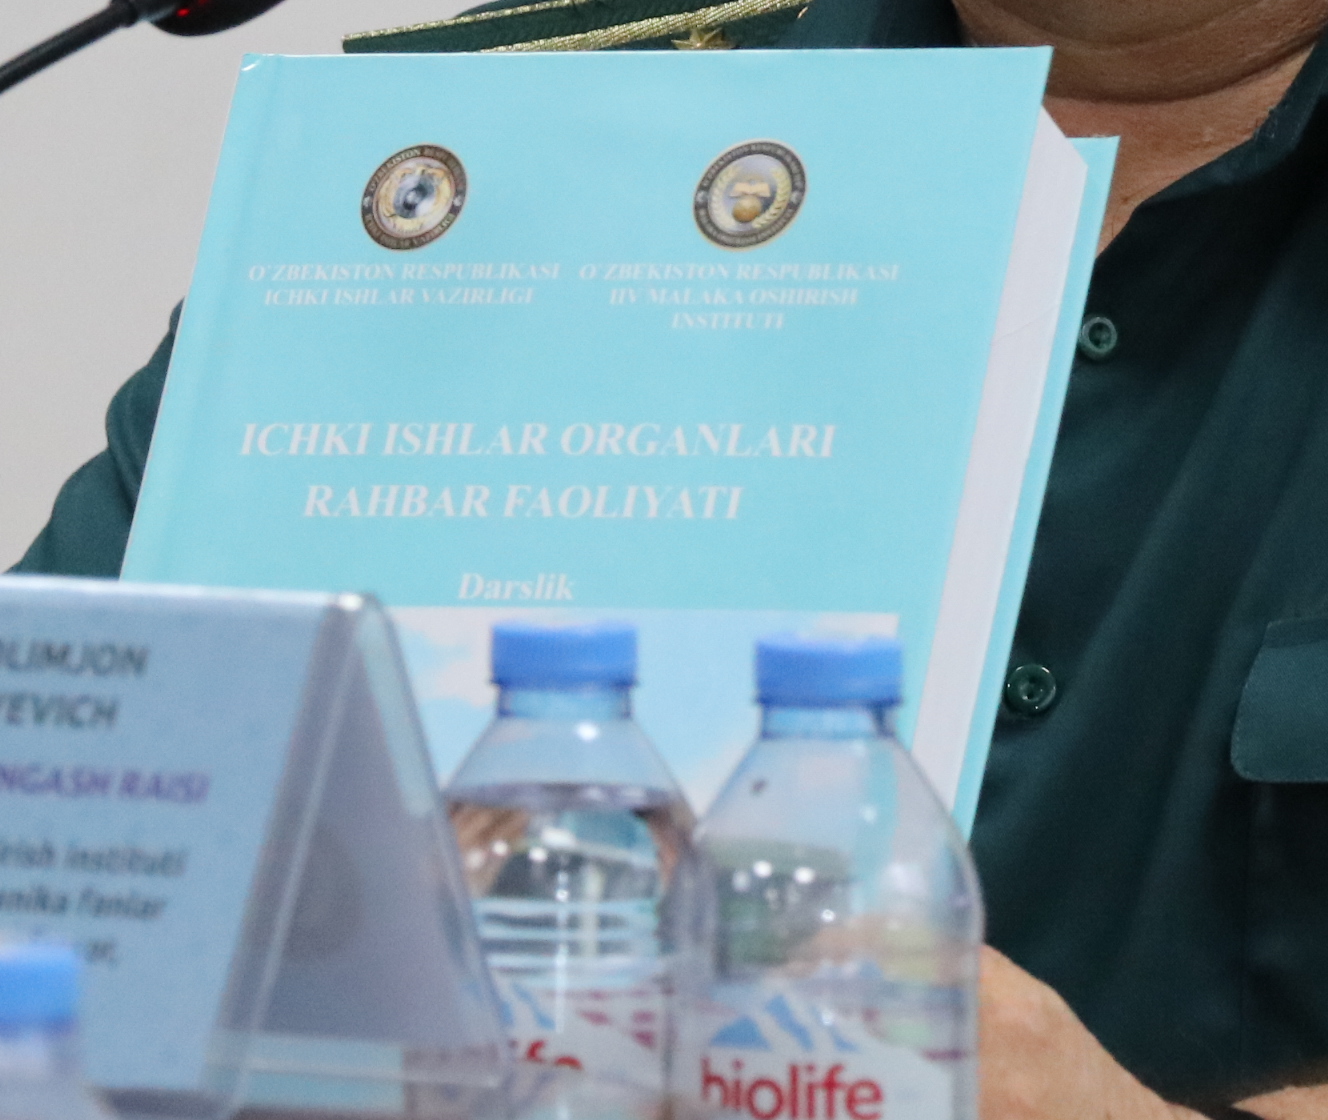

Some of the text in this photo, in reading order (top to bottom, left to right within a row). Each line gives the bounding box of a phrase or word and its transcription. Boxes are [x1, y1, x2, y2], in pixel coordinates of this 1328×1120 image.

[401, 263, 561, 280] RESPUBLIKASI
[736, 263, 901, 280] RESPUBLIKASI
[264, 286, 536, 305] ICHKI ISHLAR VAZIRLIGI
[647, 288, 744, 305] MALAKA
[749, 288, 859, 305] OSHIRISH
[672, 312, 785, 330] INSTITUTI
[240, 422, 839, 458] ICHKI ISHLAR ORGANLARI
[303, 484, 746, 520] RAHBAR FAOLIYATI
[457, 572, 575, 601] Darslik
[116, 769, 211, 804] RAISI
[76, 885, 167, 921] fanlar
[700, 1057, 883, 1120] biolife
